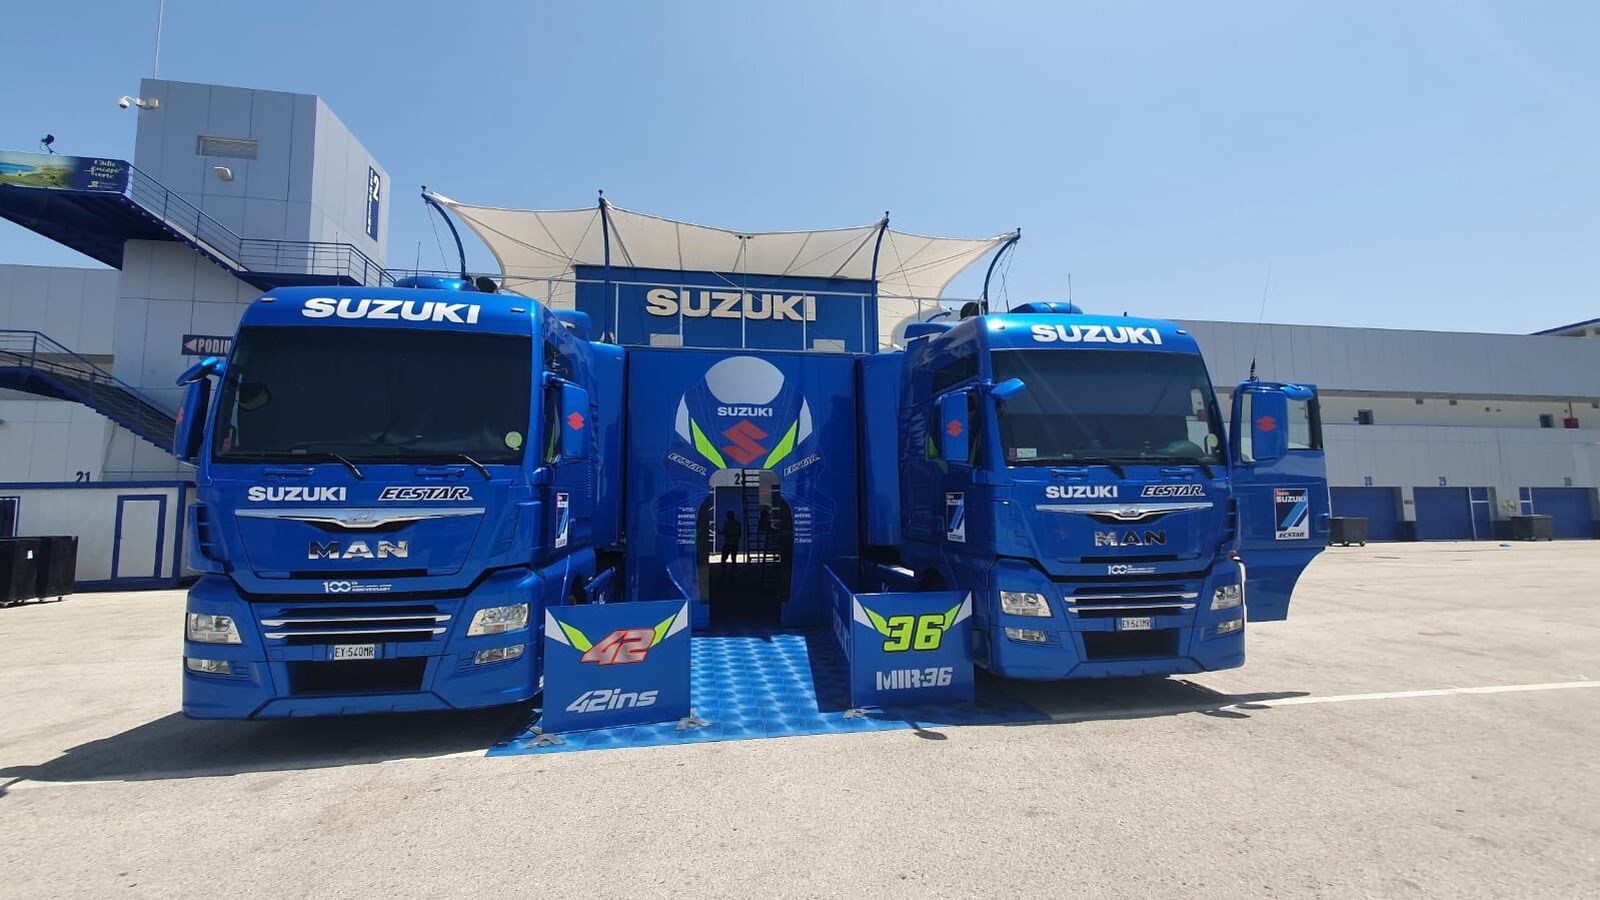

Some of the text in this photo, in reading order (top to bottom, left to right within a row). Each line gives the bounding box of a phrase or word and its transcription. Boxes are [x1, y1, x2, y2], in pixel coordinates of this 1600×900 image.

[301, 297, 481, 325] SUZUKI
[645, 288, 817, 321] SUZUKI
[1030, 323, 1163, 346] SUZUKI
[716, 406, 773, 417] SUZUKI
[76, 470, 91, 483] 21
[248, 485, 475, 502] SUZUKI ECSTAR
[1046, 484, 1206, 499] SUZUKI ECSTAR
[1095, 530, 1167, 547] MAN
[308, 540, 409, 560] MAN
[882, 613, 946, 653] 36
[580, 628, 656, 667] 42
[565, 688, 659, 713] 42ins
